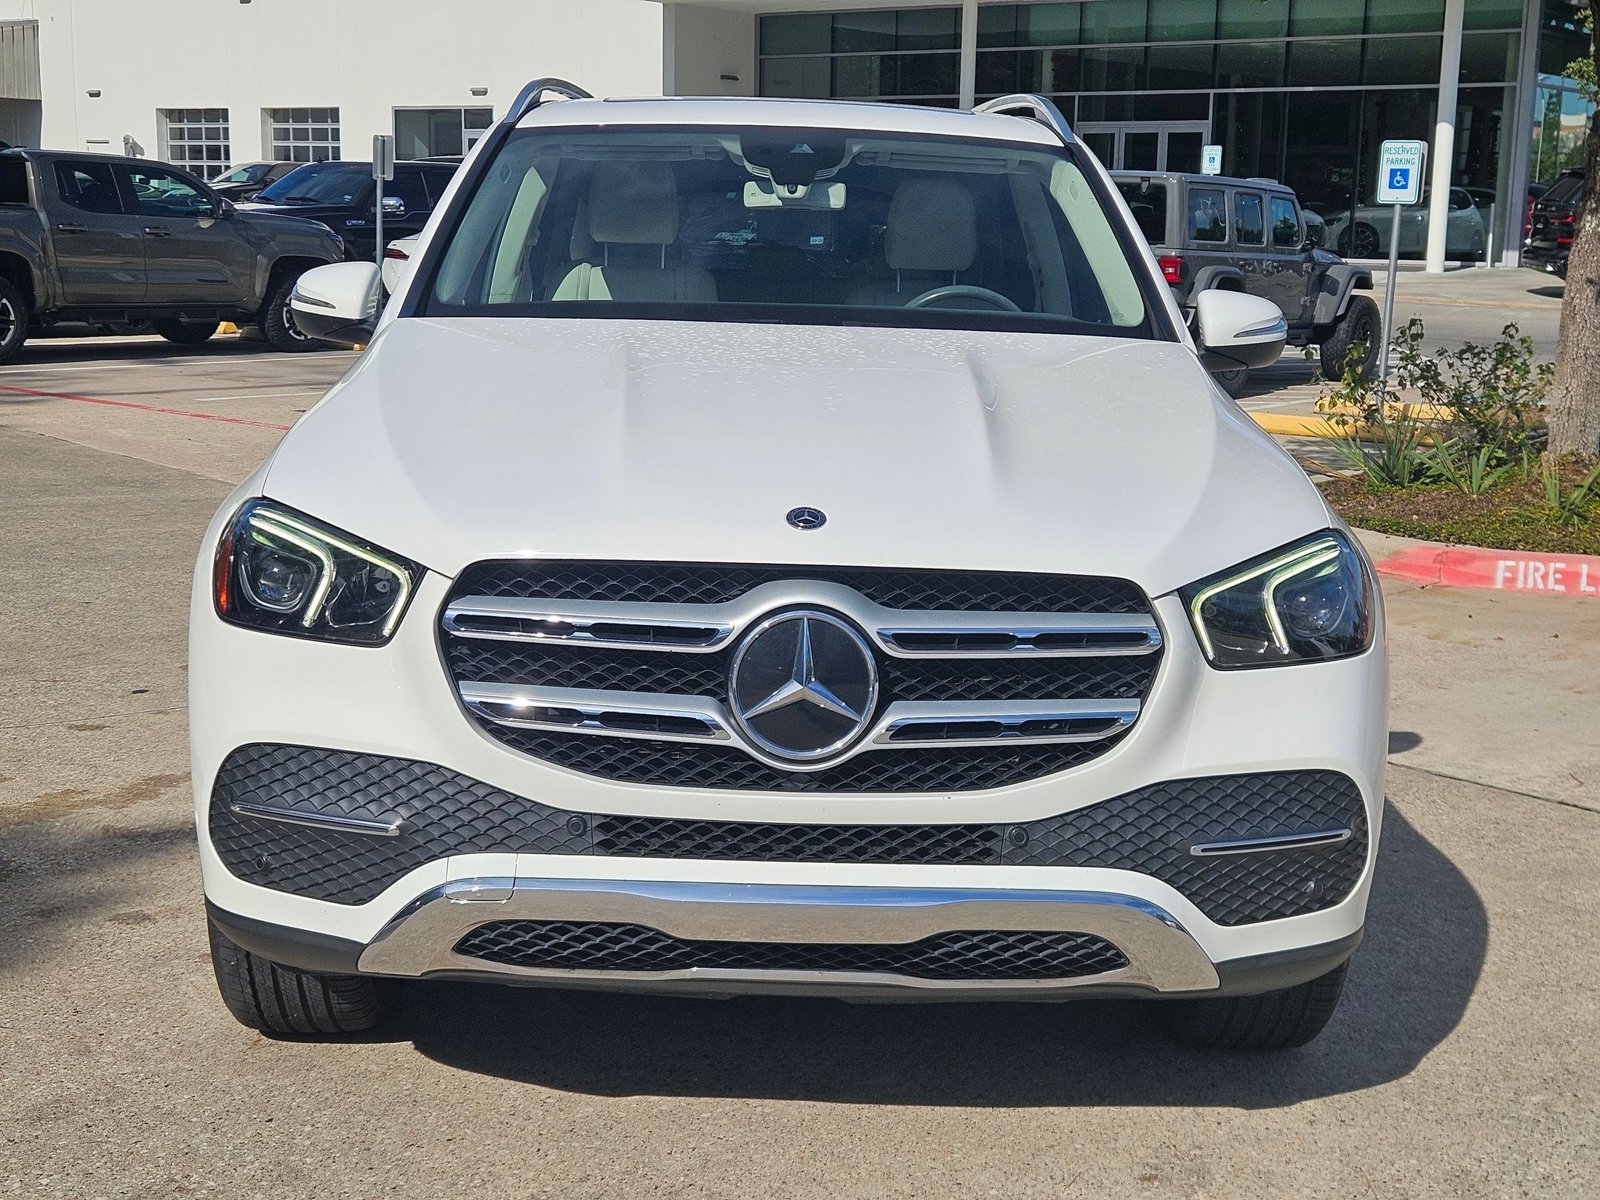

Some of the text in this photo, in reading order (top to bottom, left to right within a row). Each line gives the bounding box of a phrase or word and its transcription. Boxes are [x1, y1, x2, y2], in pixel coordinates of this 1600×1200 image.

[1384, 146, 1419, 155] RESERVED
[1386, 157, 1416, 166] PARKING
[1495, 560, 1600, 592] FIRE L
